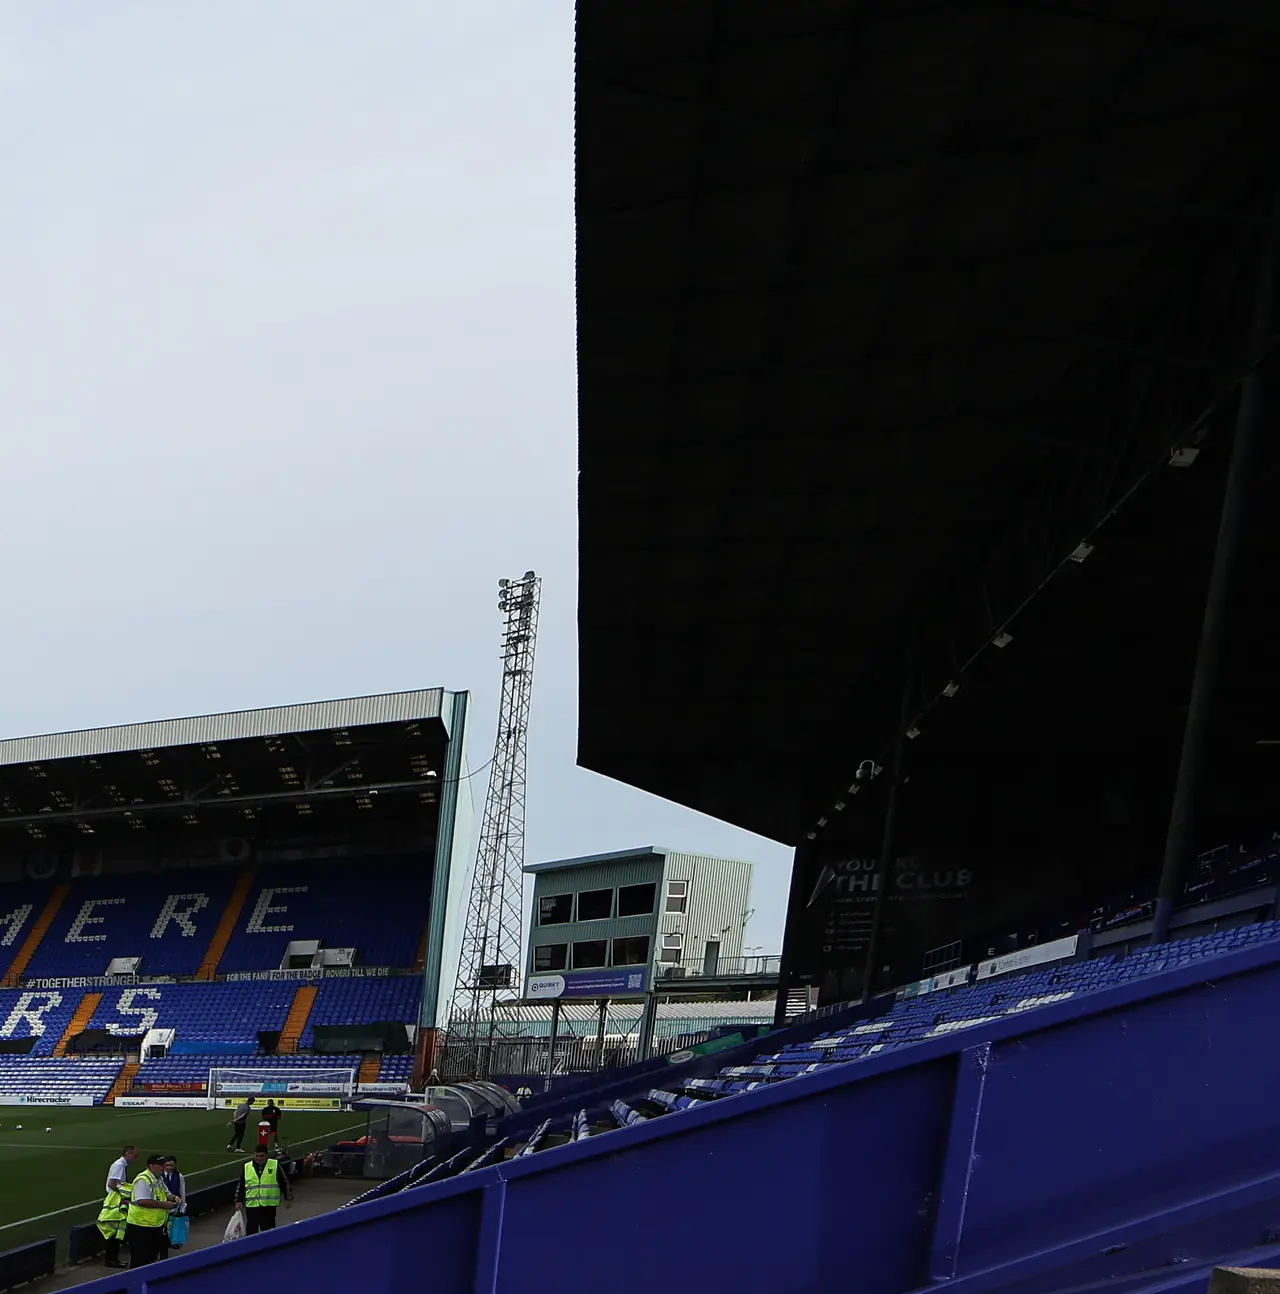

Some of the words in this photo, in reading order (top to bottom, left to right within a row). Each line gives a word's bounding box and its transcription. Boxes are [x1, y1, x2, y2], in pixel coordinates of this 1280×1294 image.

[836, 857, 876, 872] YOU
[895, 867, 973, 889] CLUB
[25, 975, 140, 989] #TOGETHERSTRONGER
[226, 973, 239, 982] FOR
[240, 973, 251, 981] THE
